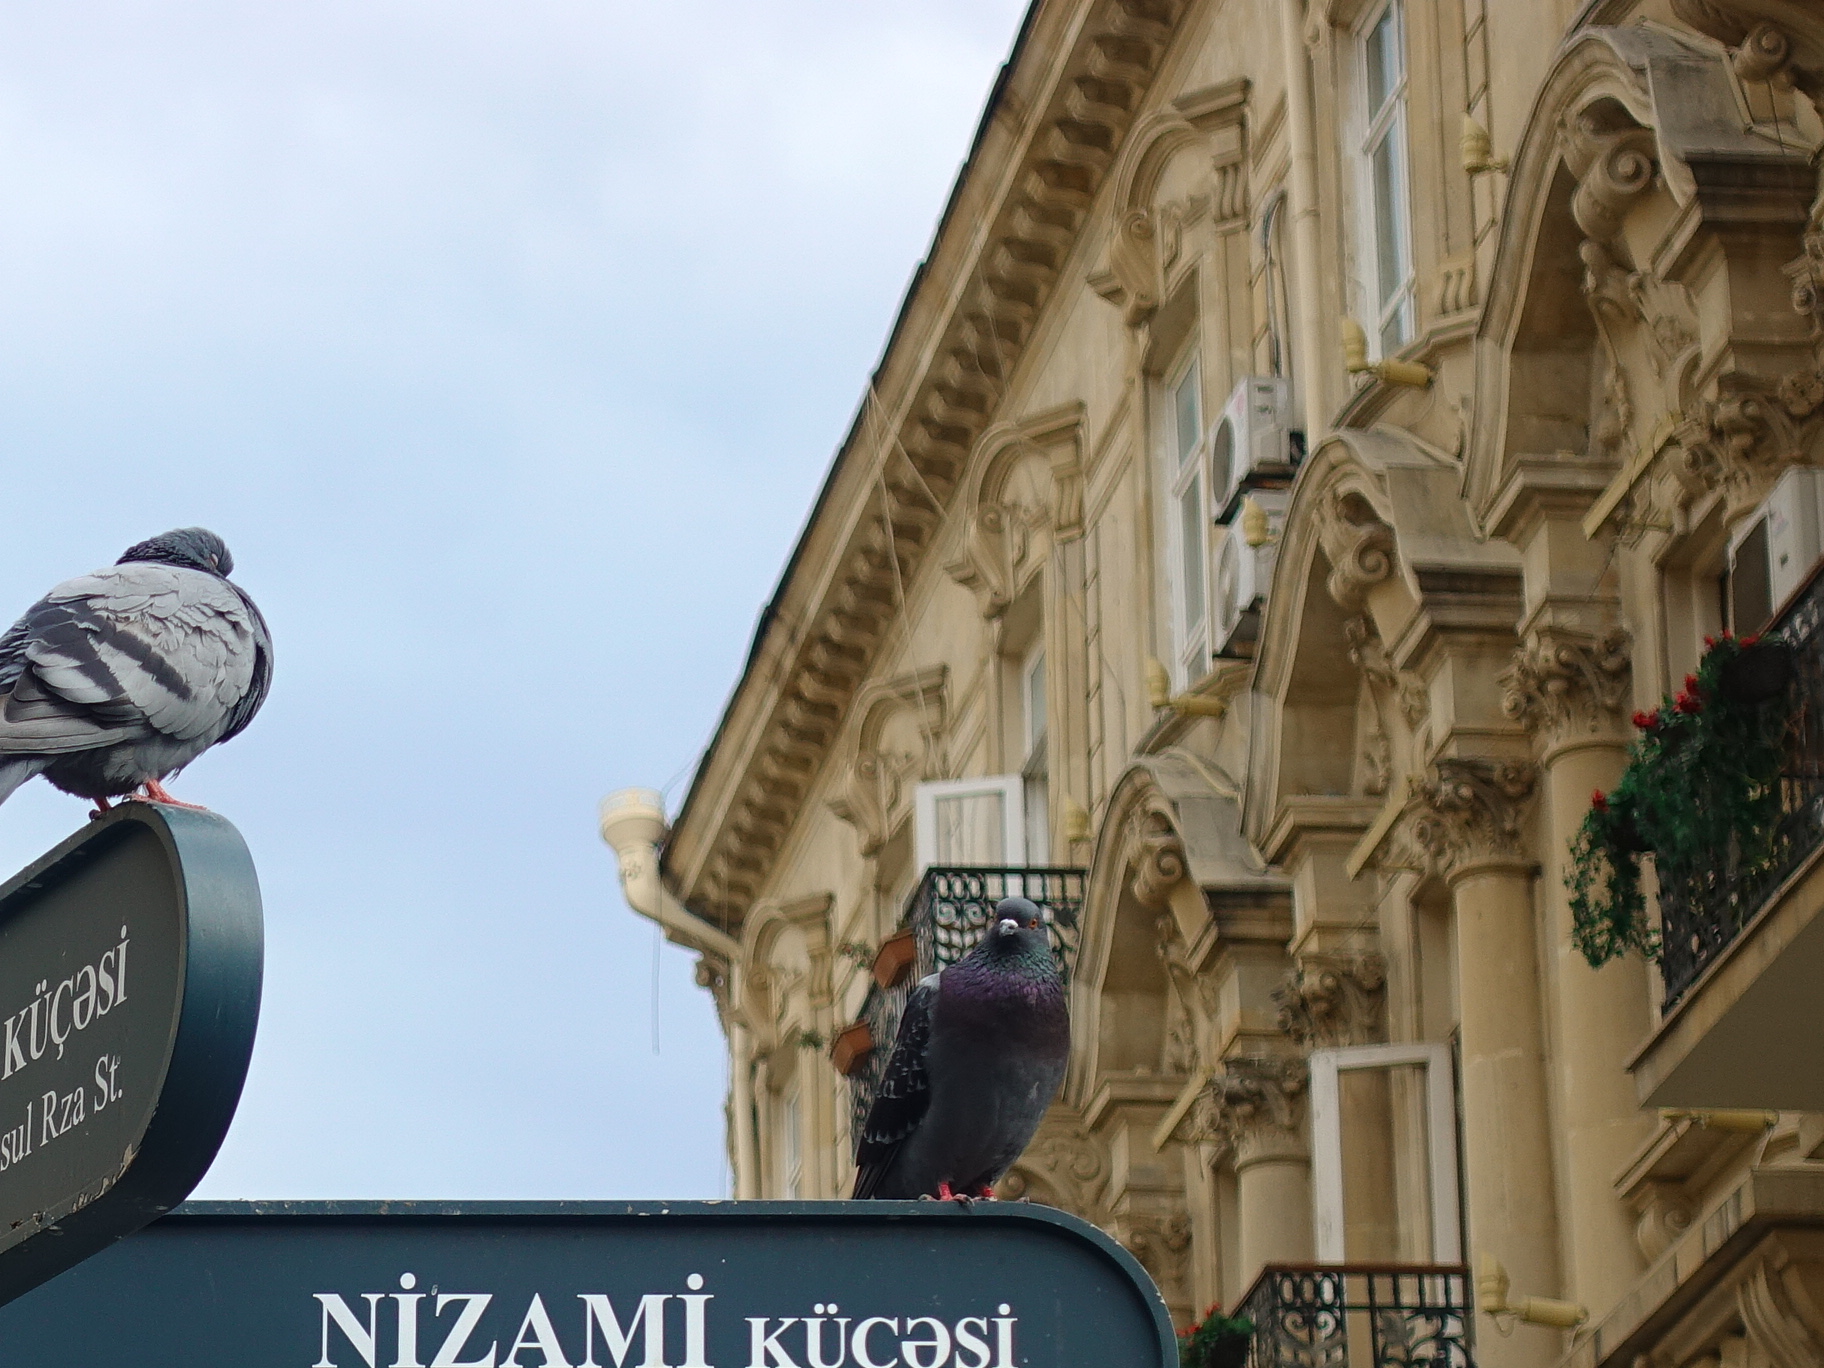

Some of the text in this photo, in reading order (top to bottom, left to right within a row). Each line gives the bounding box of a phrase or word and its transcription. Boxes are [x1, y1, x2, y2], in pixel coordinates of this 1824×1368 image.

[0, 924, 131, 1082] KÜÇƏSİ
[39, 1086, 86, 1148] Rza
[93, 1053, 124, 1115] St.
